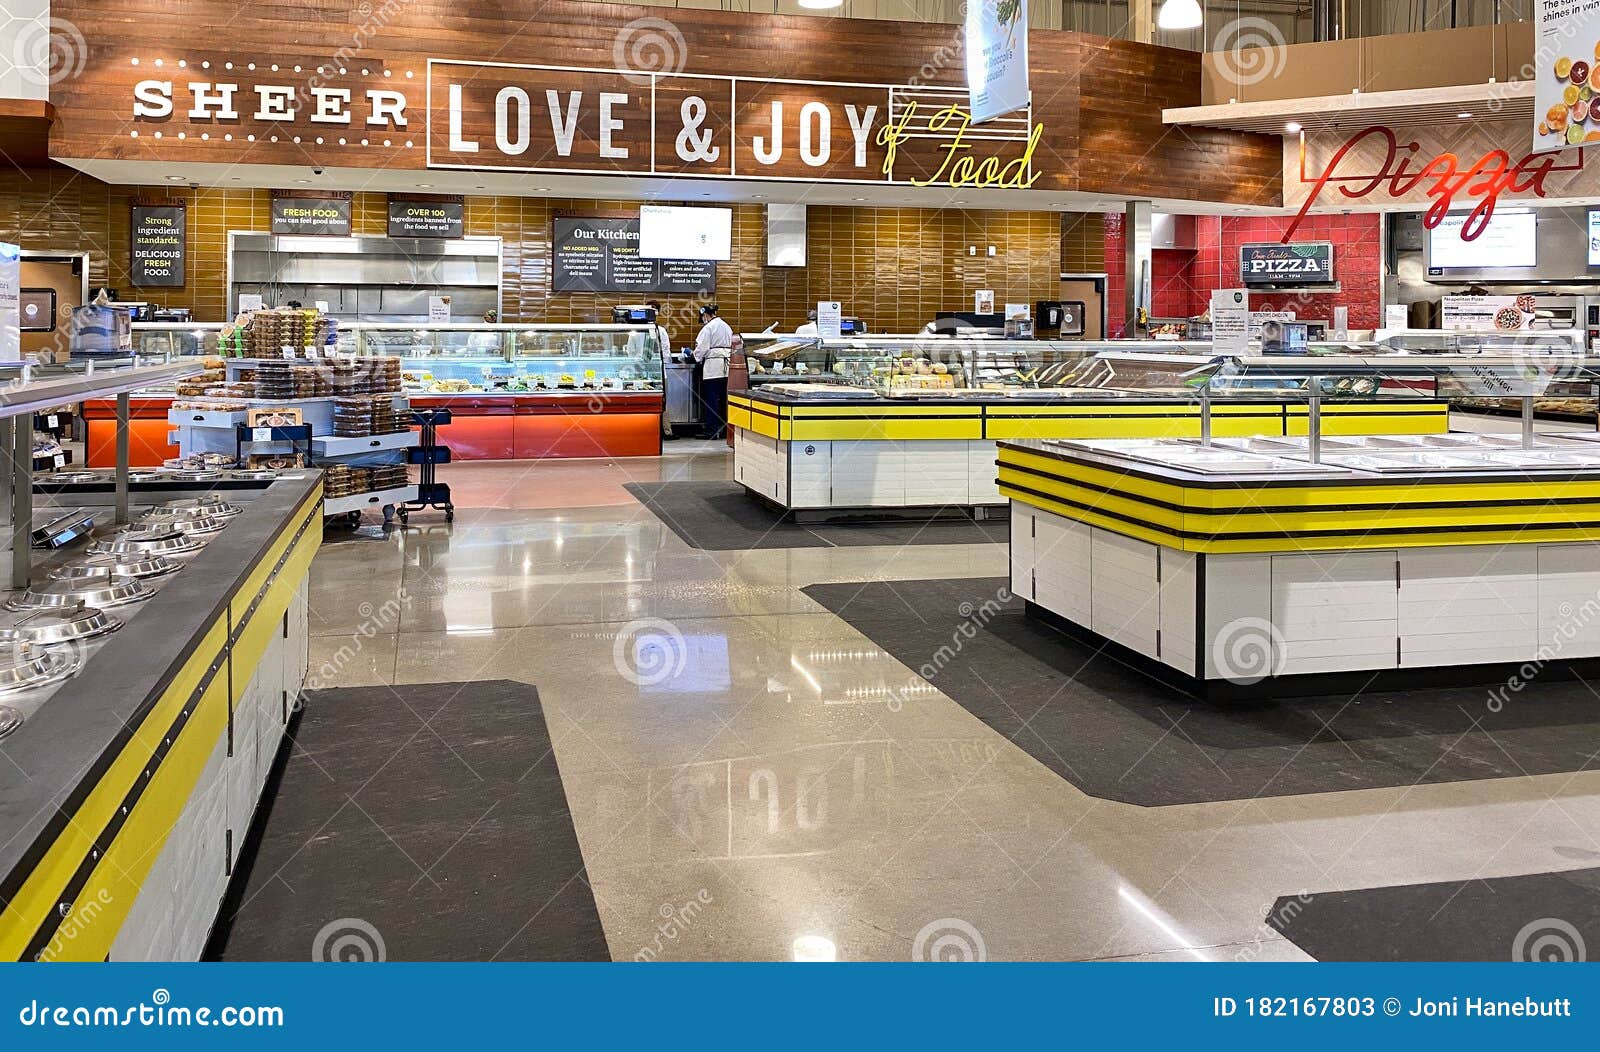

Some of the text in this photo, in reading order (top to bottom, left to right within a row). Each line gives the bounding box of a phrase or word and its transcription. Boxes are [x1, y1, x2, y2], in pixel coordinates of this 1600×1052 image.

[1543, 0, 1559, 10] The
[1543, 9, 1570, 22] shines
[1571, 5, 1580, 14] in
[133, 80, 1043, 188] SHEER LOVE & JOY of Food
[1281, 126, 1556, 243] Pizza
[283, 208, 338, 217] FRESH FOOD
[407, 208, 430, 216] OVER
[145, 217, 172, 226] Strong
[390, 215, 423, 223] ingredients
[137, 226, 180, 236] ingredient
[574, 228, 639, 240] Our Kitchen
[135, 250, 181, 258] DELICIOUS
[1251, 259, 1321, 273] PIZZA
[144, 268, 171, 276] FOOD.
